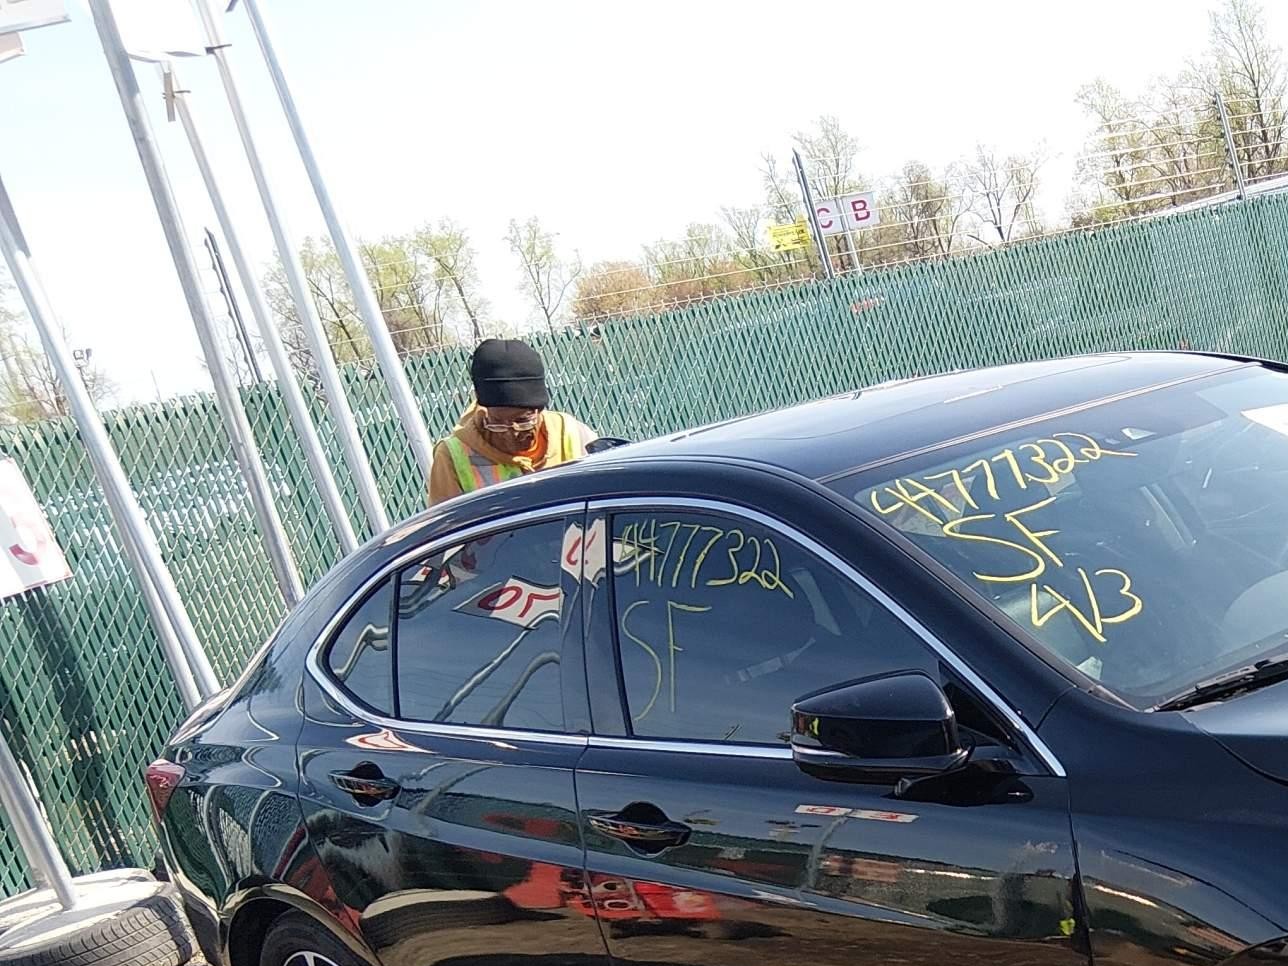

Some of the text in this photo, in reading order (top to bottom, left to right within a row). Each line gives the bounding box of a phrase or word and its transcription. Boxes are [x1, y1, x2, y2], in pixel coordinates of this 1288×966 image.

[817, 208, 833, 228] C
[851, 200, 870, 221] B
[871, 432, 1139, 524] 44777322
[620, 519, 795, 599] 44777322
[942, 496, 1062, 582] SF
[622, 601, 712, 721] SF
